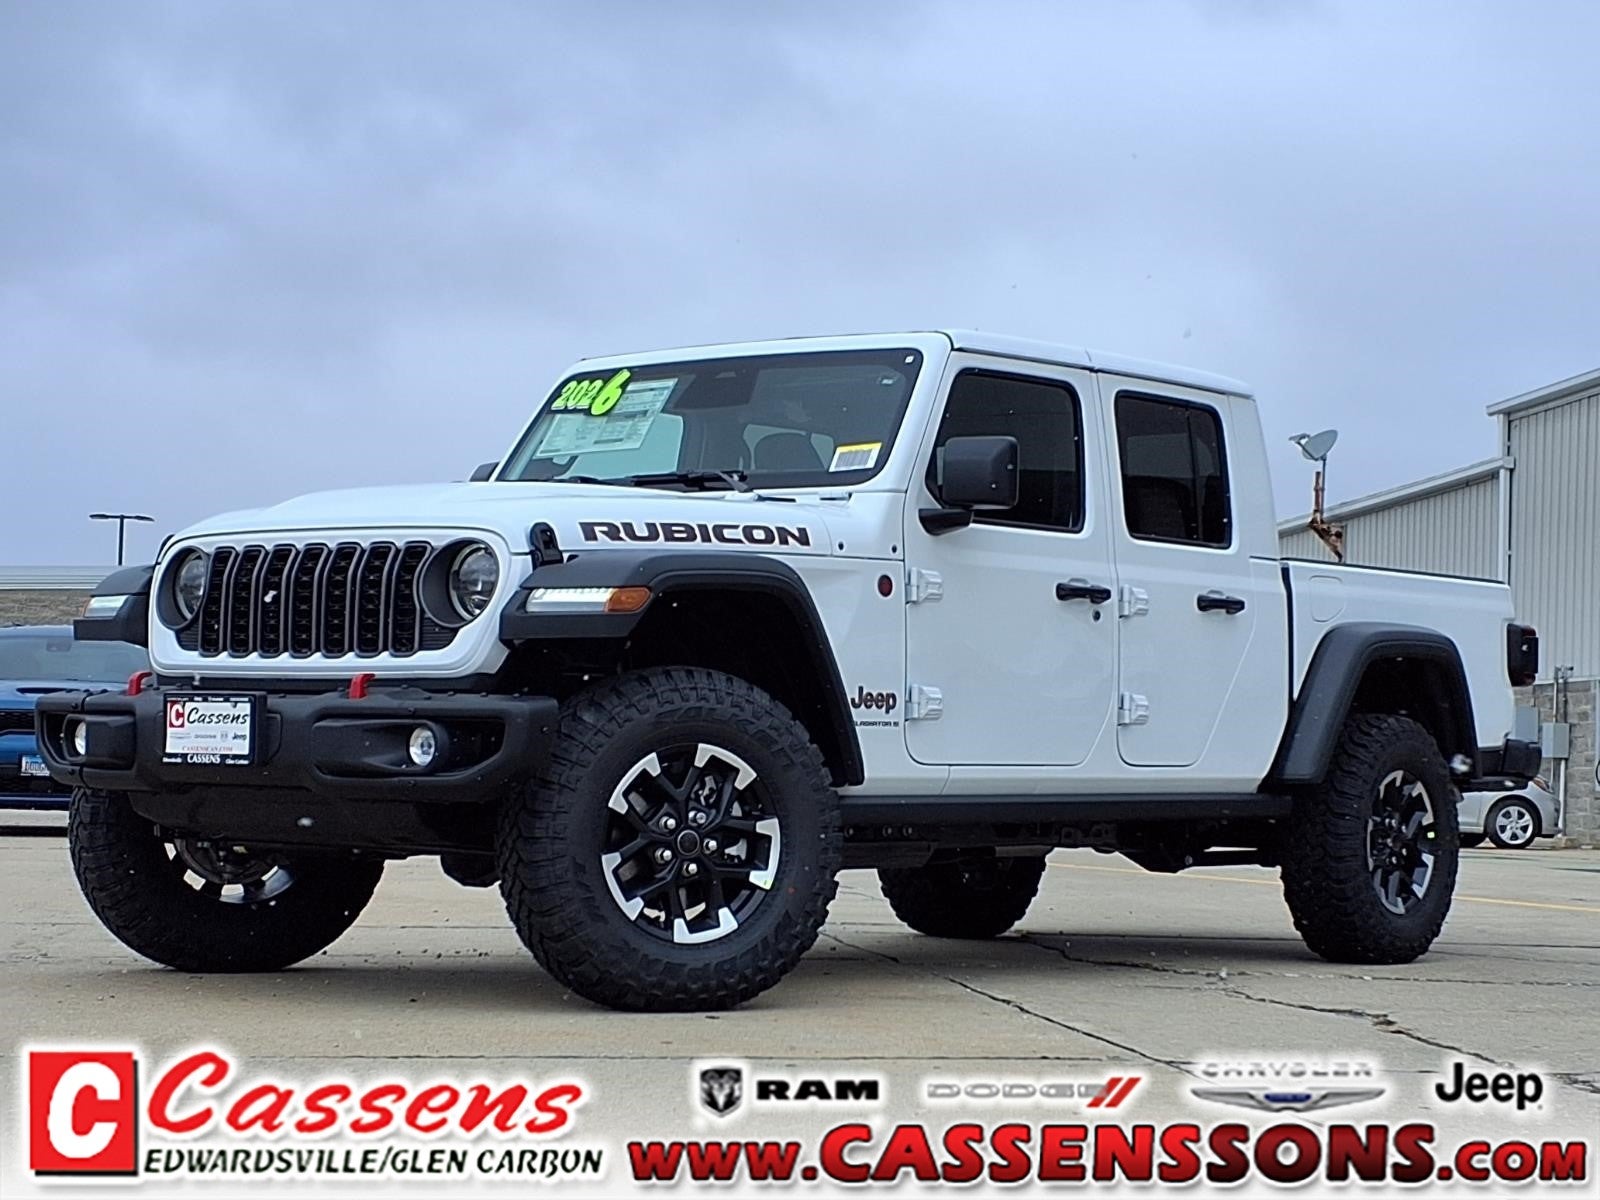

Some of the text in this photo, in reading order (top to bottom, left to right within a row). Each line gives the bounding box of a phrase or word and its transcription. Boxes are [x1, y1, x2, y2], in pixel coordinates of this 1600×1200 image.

[551, 369, 631, 416] 2026
[578, 521, 811, 547] RUBICON
[851, 686, 897, 715] Jeep
[187, 707, 249, 725] Cassens
[187, 754, 221, 764] CASSENS
